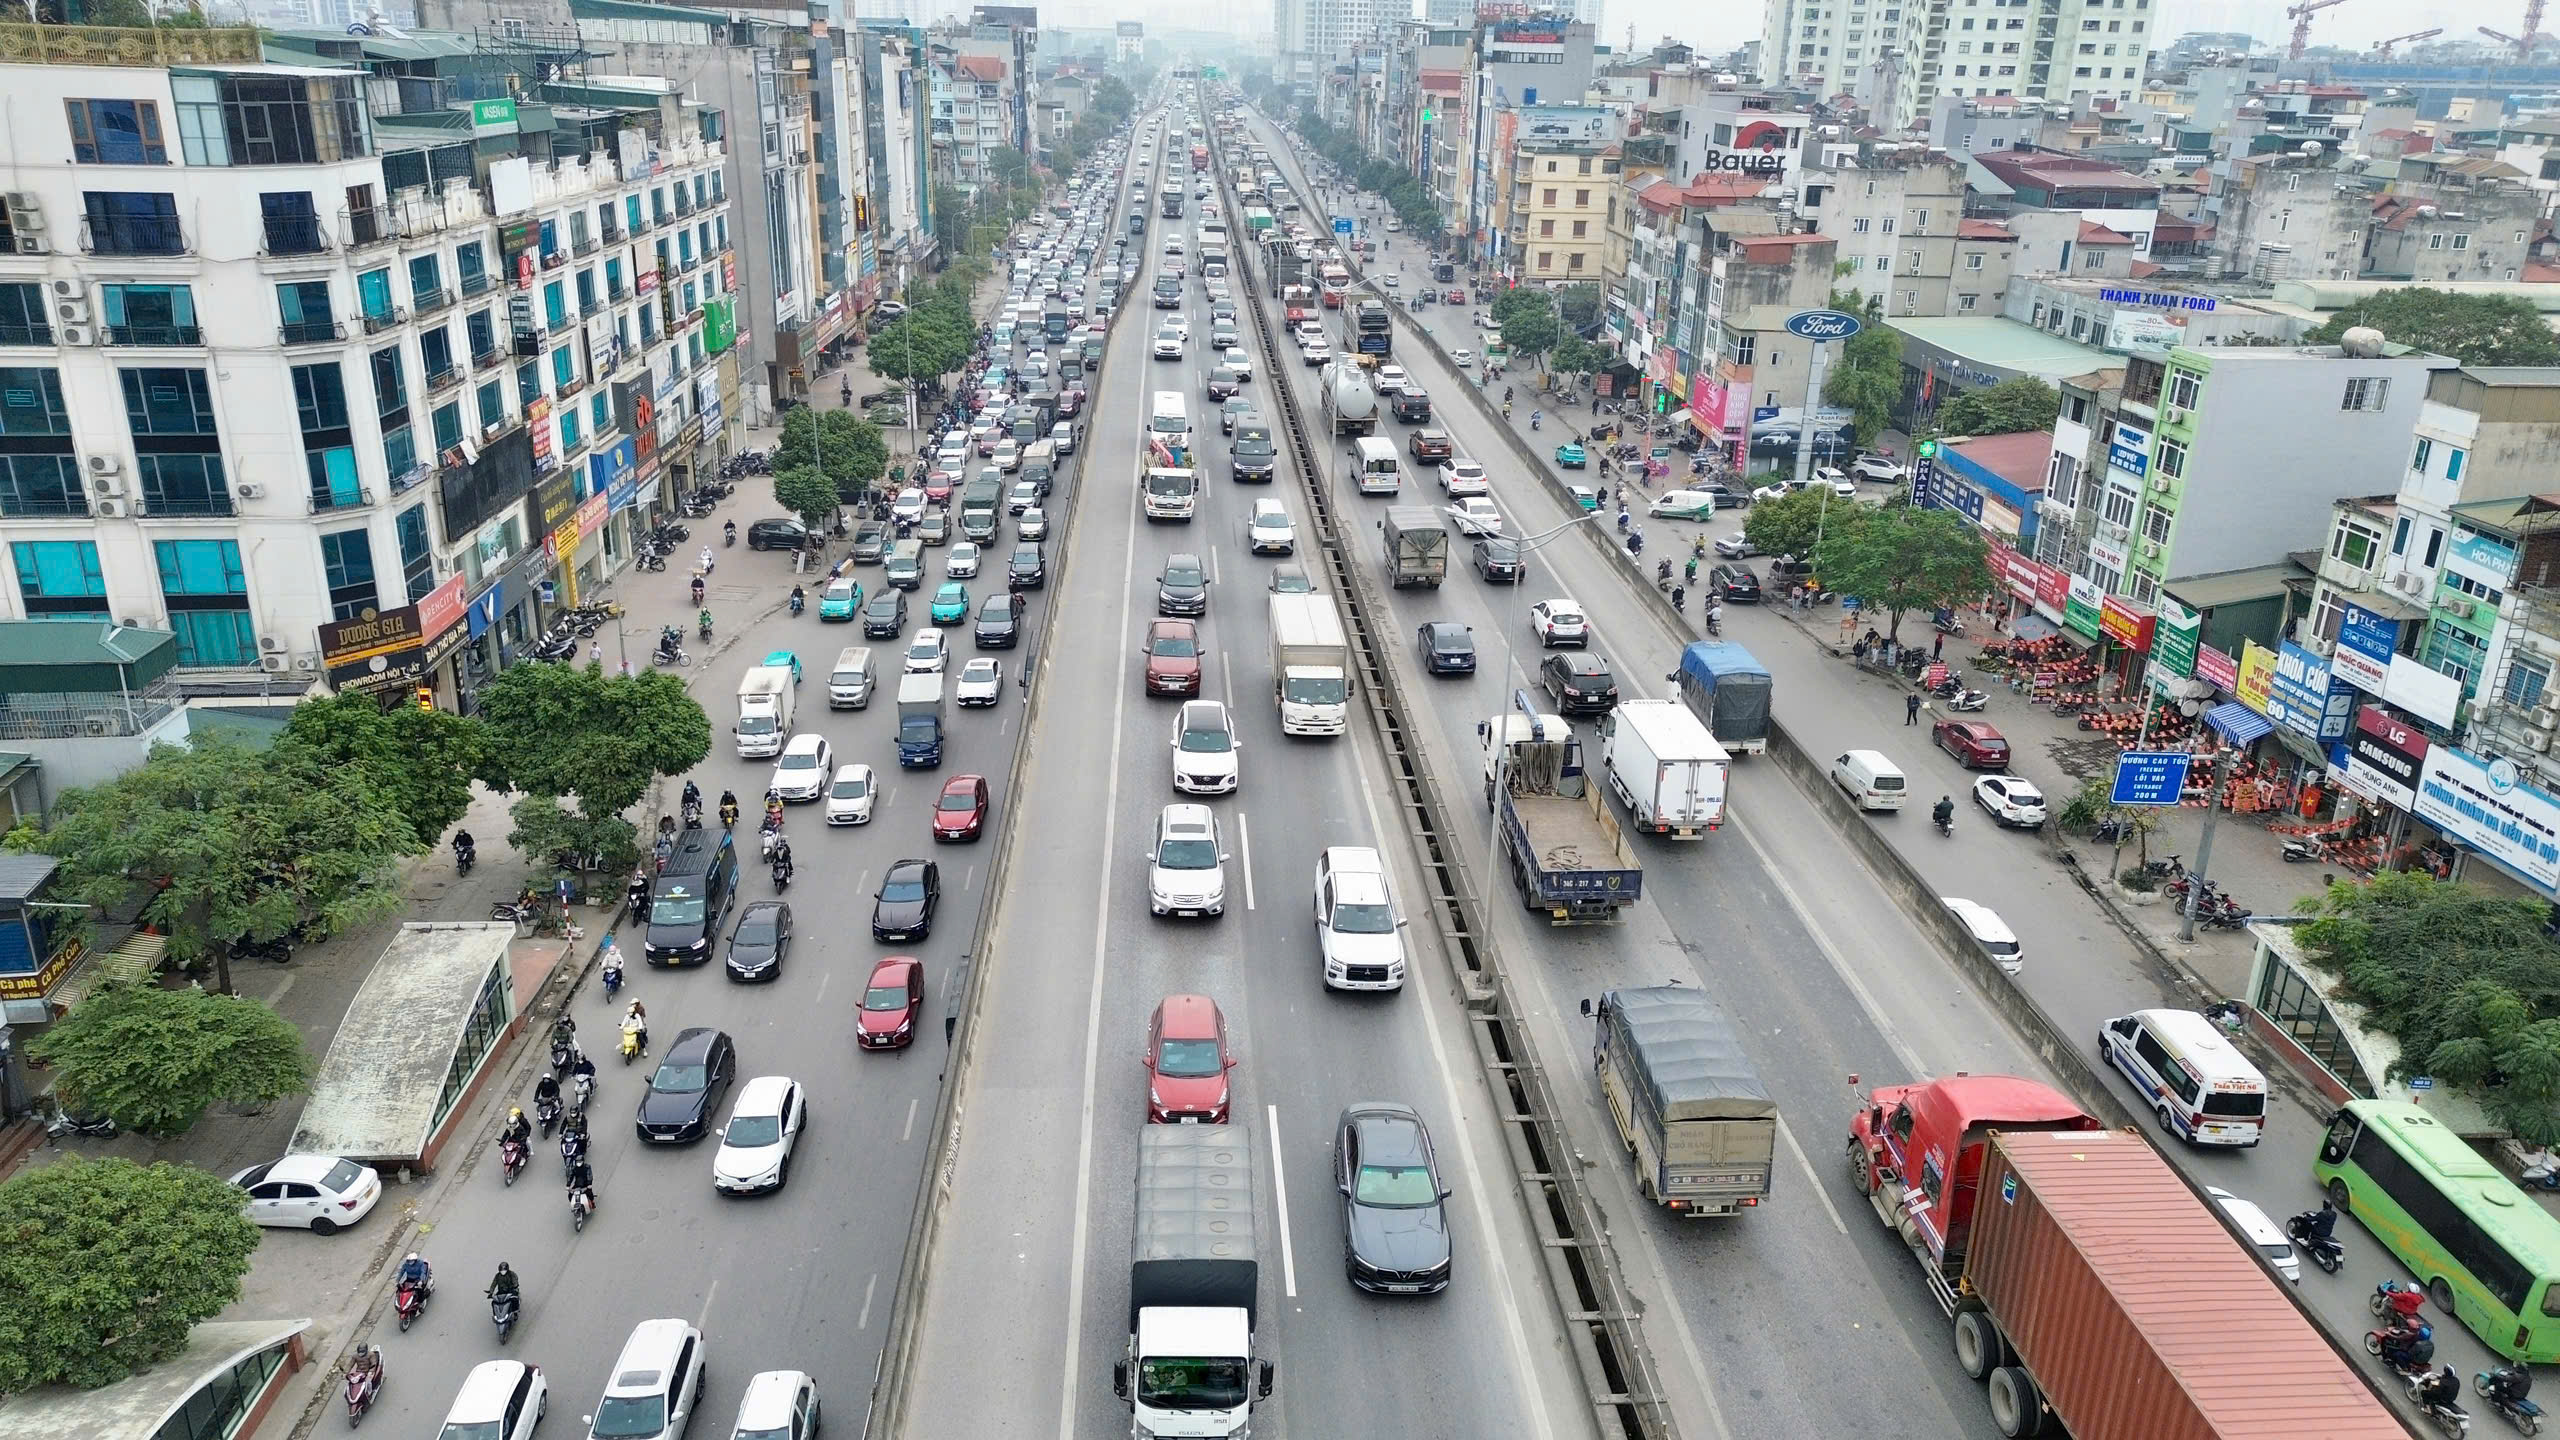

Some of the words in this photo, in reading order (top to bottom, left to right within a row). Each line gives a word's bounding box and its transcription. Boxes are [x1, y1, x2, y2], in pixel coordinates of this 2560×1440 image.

[1706, 150, 1786, 171] Bauer
[2100, 288, 2141, 303] THANH
[2143, 293, 2178, 307] XUAN
[2181, 297, 2215, 311] FORD
[1801, 315, 1847, 334] Ford
[1973, 370, 1999, 387] FORD
[2119, 427, 2144, 444] PHILIPS
[2094, 546, 2106, 558] LED
[382, 616, 405, 635] GIA
[2359, 614, 2377, 629] TLC
[2277, 651, 2304, 684] KHÓA
[2336, 651, 2357, 667] PHÚC
[2357, 661, 2384, 680] QUANG
[340, 672, 386, 690] SHOWROOM
[401, 661, 420, 675] TẤT
[2267, 700, 2285, 720] 60
[2389, 727, 2407, 745] LG
[2122, 756, 2148, 764] ĐƯỜNG
[2359, 740, 2412, 778] SAMSUNG
[2135, 773, 2147, 781] LỐI
[2152, 773, 2166, 781] VÀO
[2383, 782, 2398, 796] ANH
[2452, 778, 2460, 786] TY
[2545, 828, 2555, 837] AN
[2423, 779, 2455, 808] PHÒNG
[2454, 796, 2485, 824] KHÁM
[2522, 832, 2538, 854] HÀ
[2538, 842, 2559, 865] NỘI
[0, 978, 15, 990] Cà
[17, 977, 37, 989] phê
